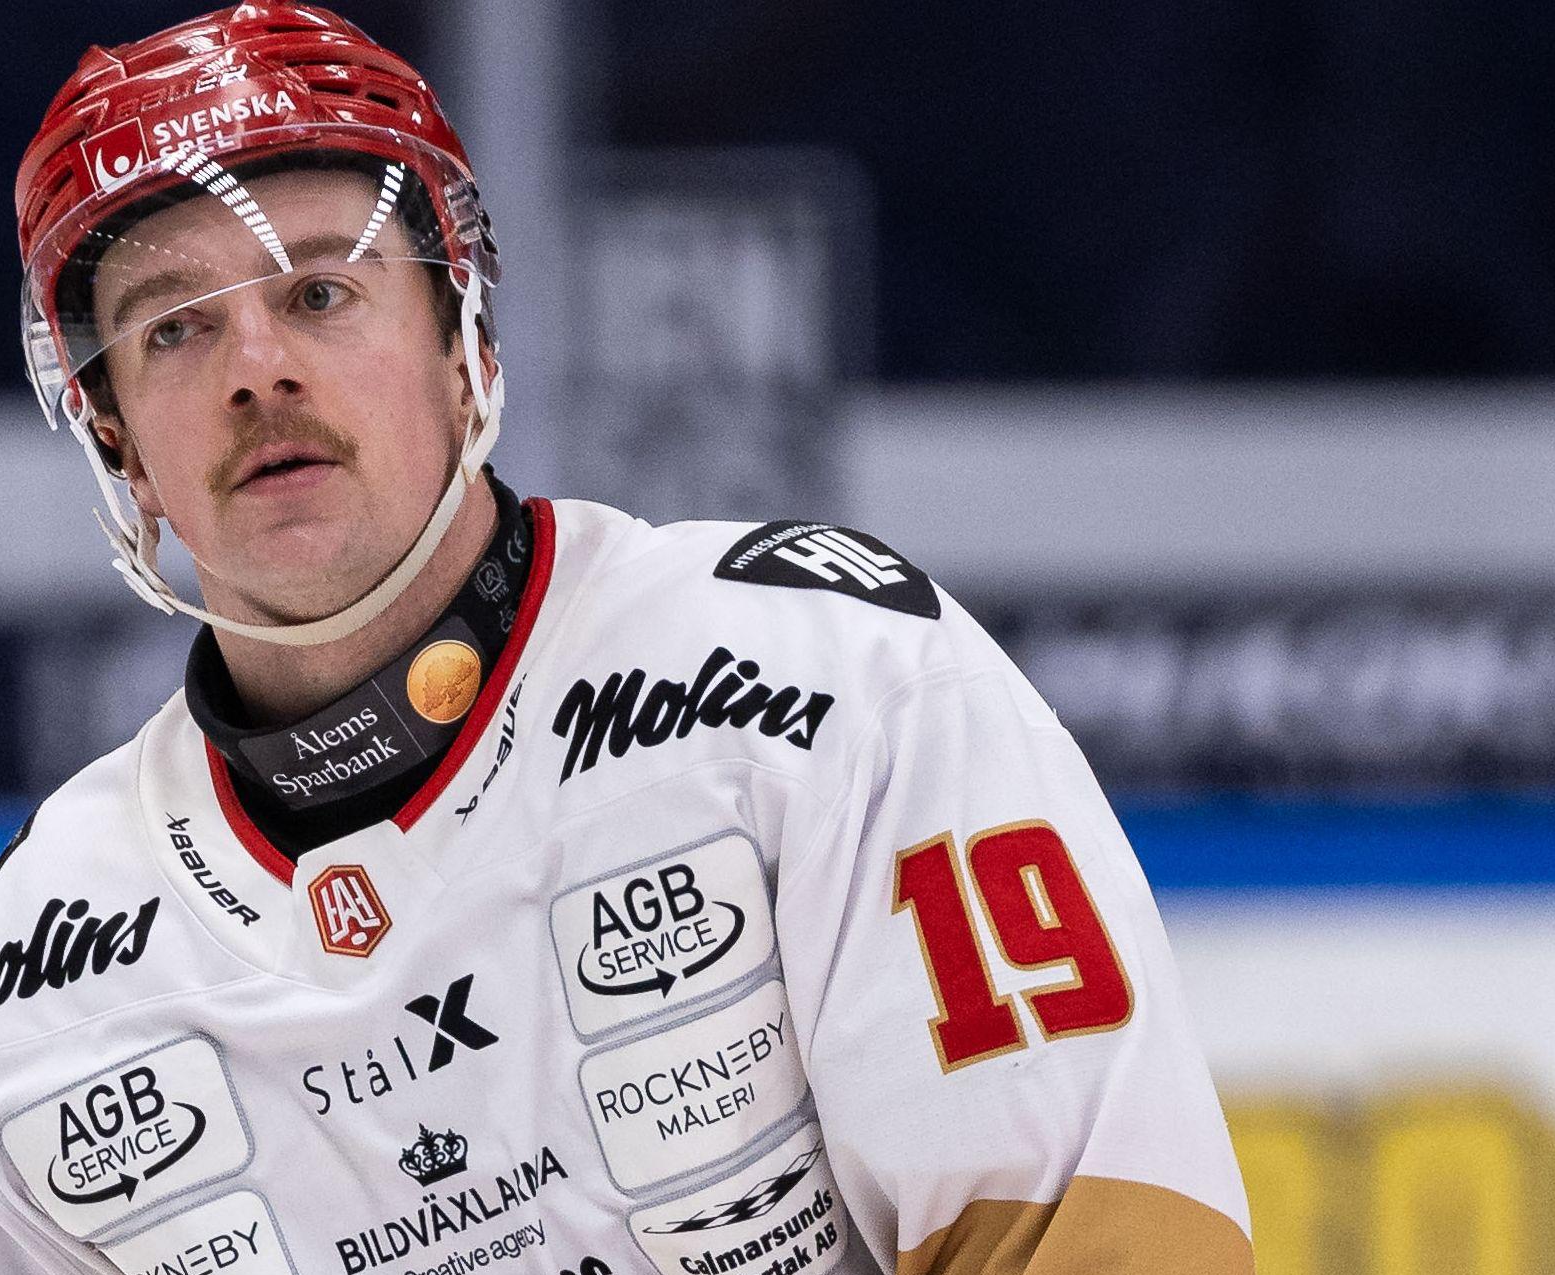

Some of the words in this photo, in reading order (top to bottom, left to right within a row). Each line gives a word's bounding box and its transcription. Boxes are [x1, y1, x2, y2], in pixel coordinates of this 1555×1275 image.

[152, 90, 296, 145] SVENSKA
[290, 706, 379, 761] Ålems
[552, 646, 836, 788] Molins
[271, 736, 401, 798] Sparbank
[171, 833, 262, 928] BAUER
[593, 863, 705, 950] AGB
[598, 917, 718, 980] SERVICE
[891, 818, 1136, 1076] 19
[596, 1011, 785, 1123] ROCKNEBY
[58, 1066, 166, 1158] AGB
[656, 1082, 756, 1141] MÅLERI
[66, 1119, 177, 1188] SERVICE
[679, 1188, 834, 1275] Calmarsunds
[815, 1221, 839, 1258] AB
